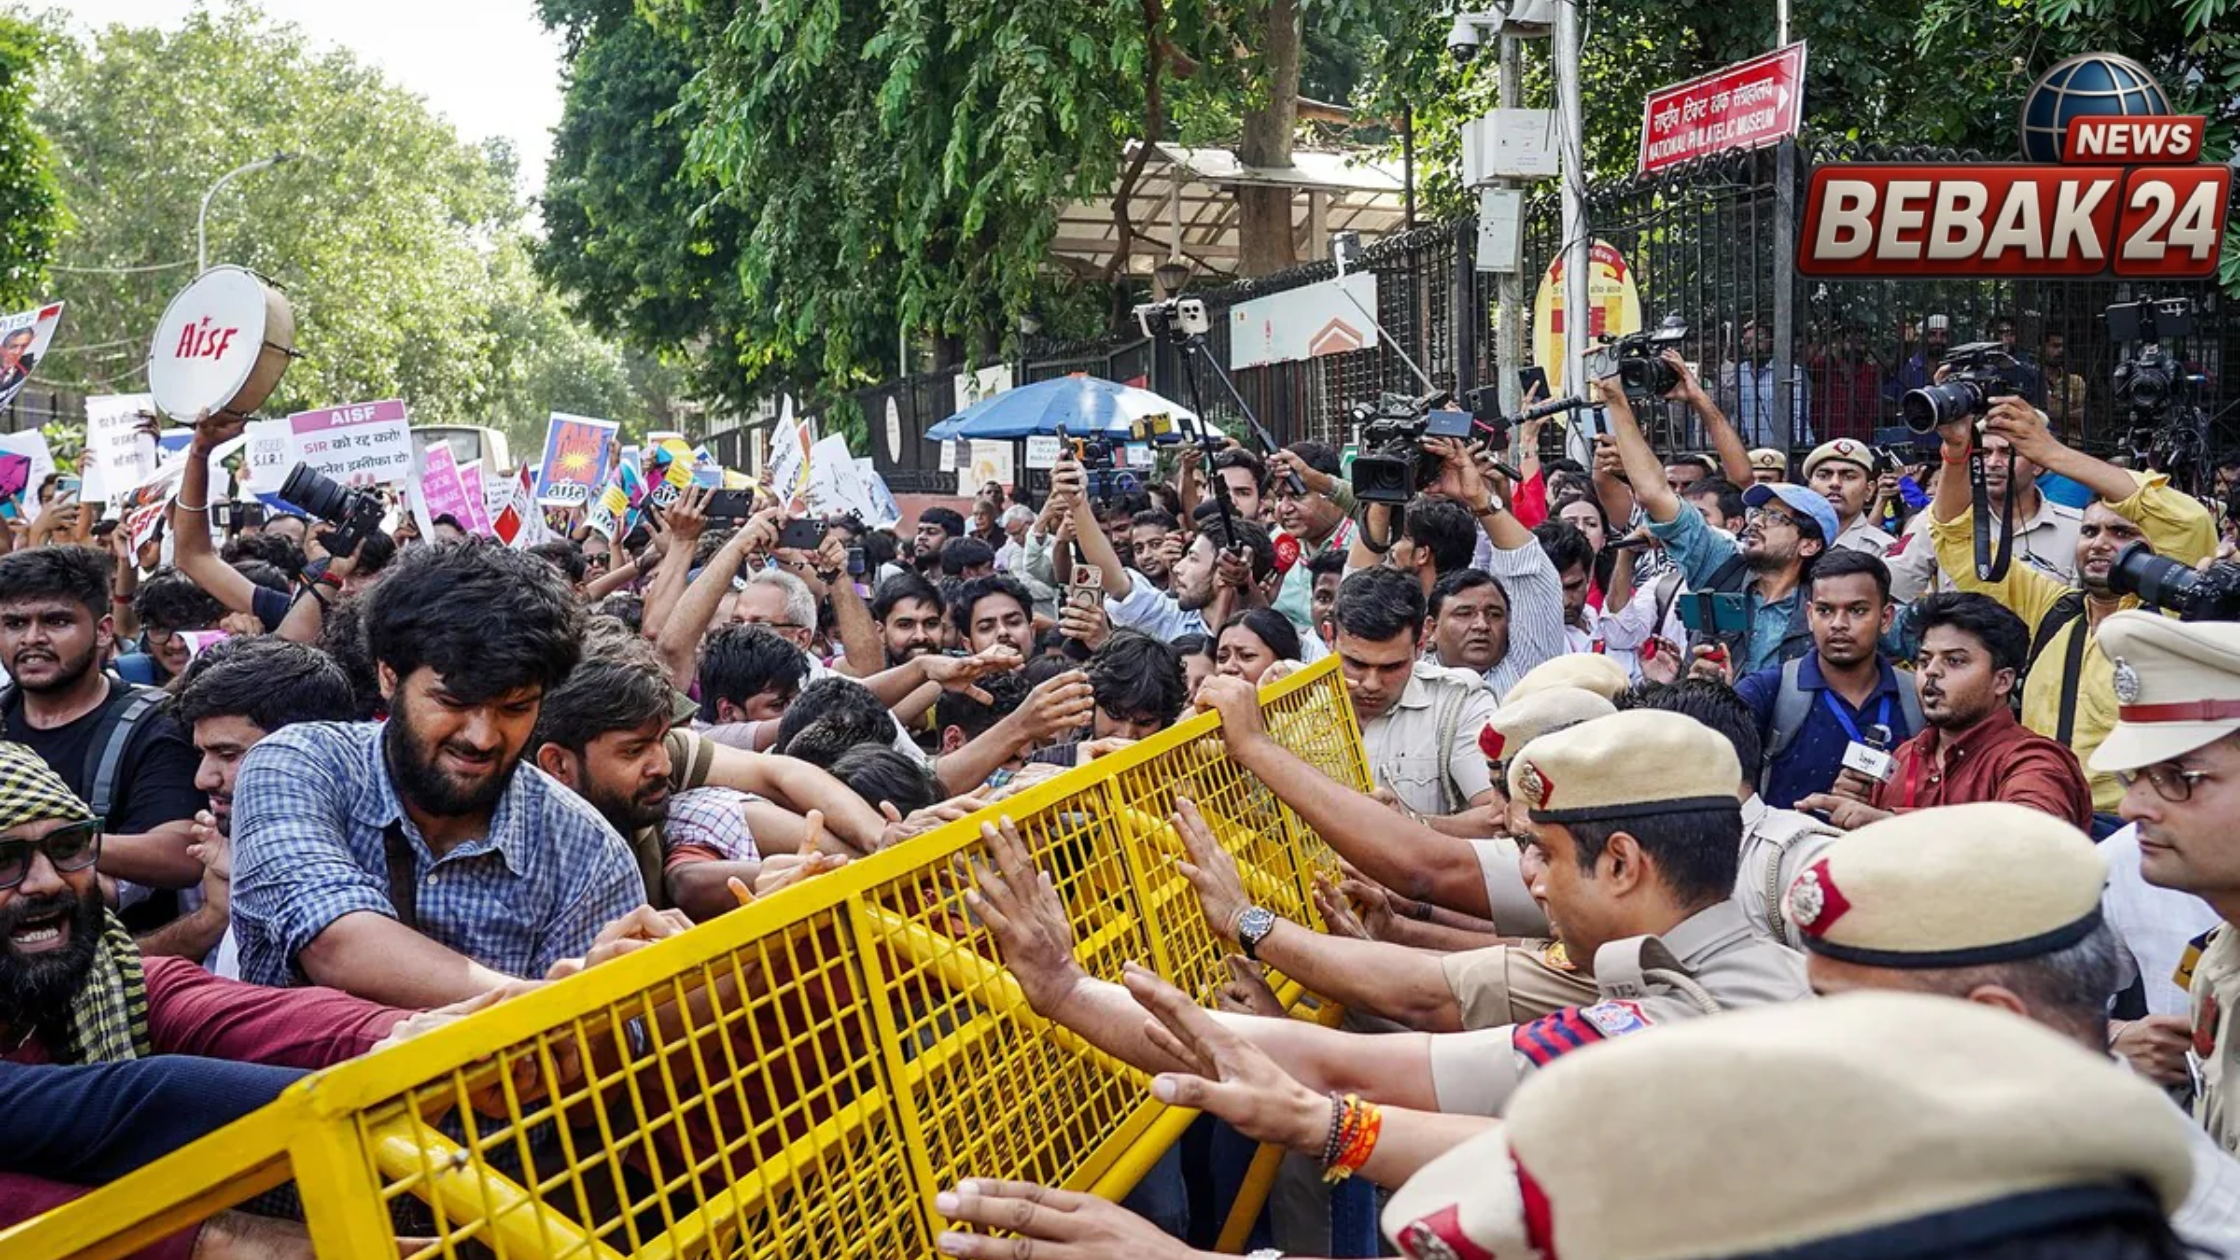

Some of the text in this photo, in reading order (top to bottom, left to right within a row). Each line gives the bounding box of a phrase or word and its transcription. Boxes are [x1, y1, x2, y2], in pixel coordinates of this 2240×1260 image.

[1648, 106, 1776, 162] NATIONAL PHILATELIC MUSEUM
[330, 405, 376, 426] AISF
[304, 440, 328, 455] SIR
